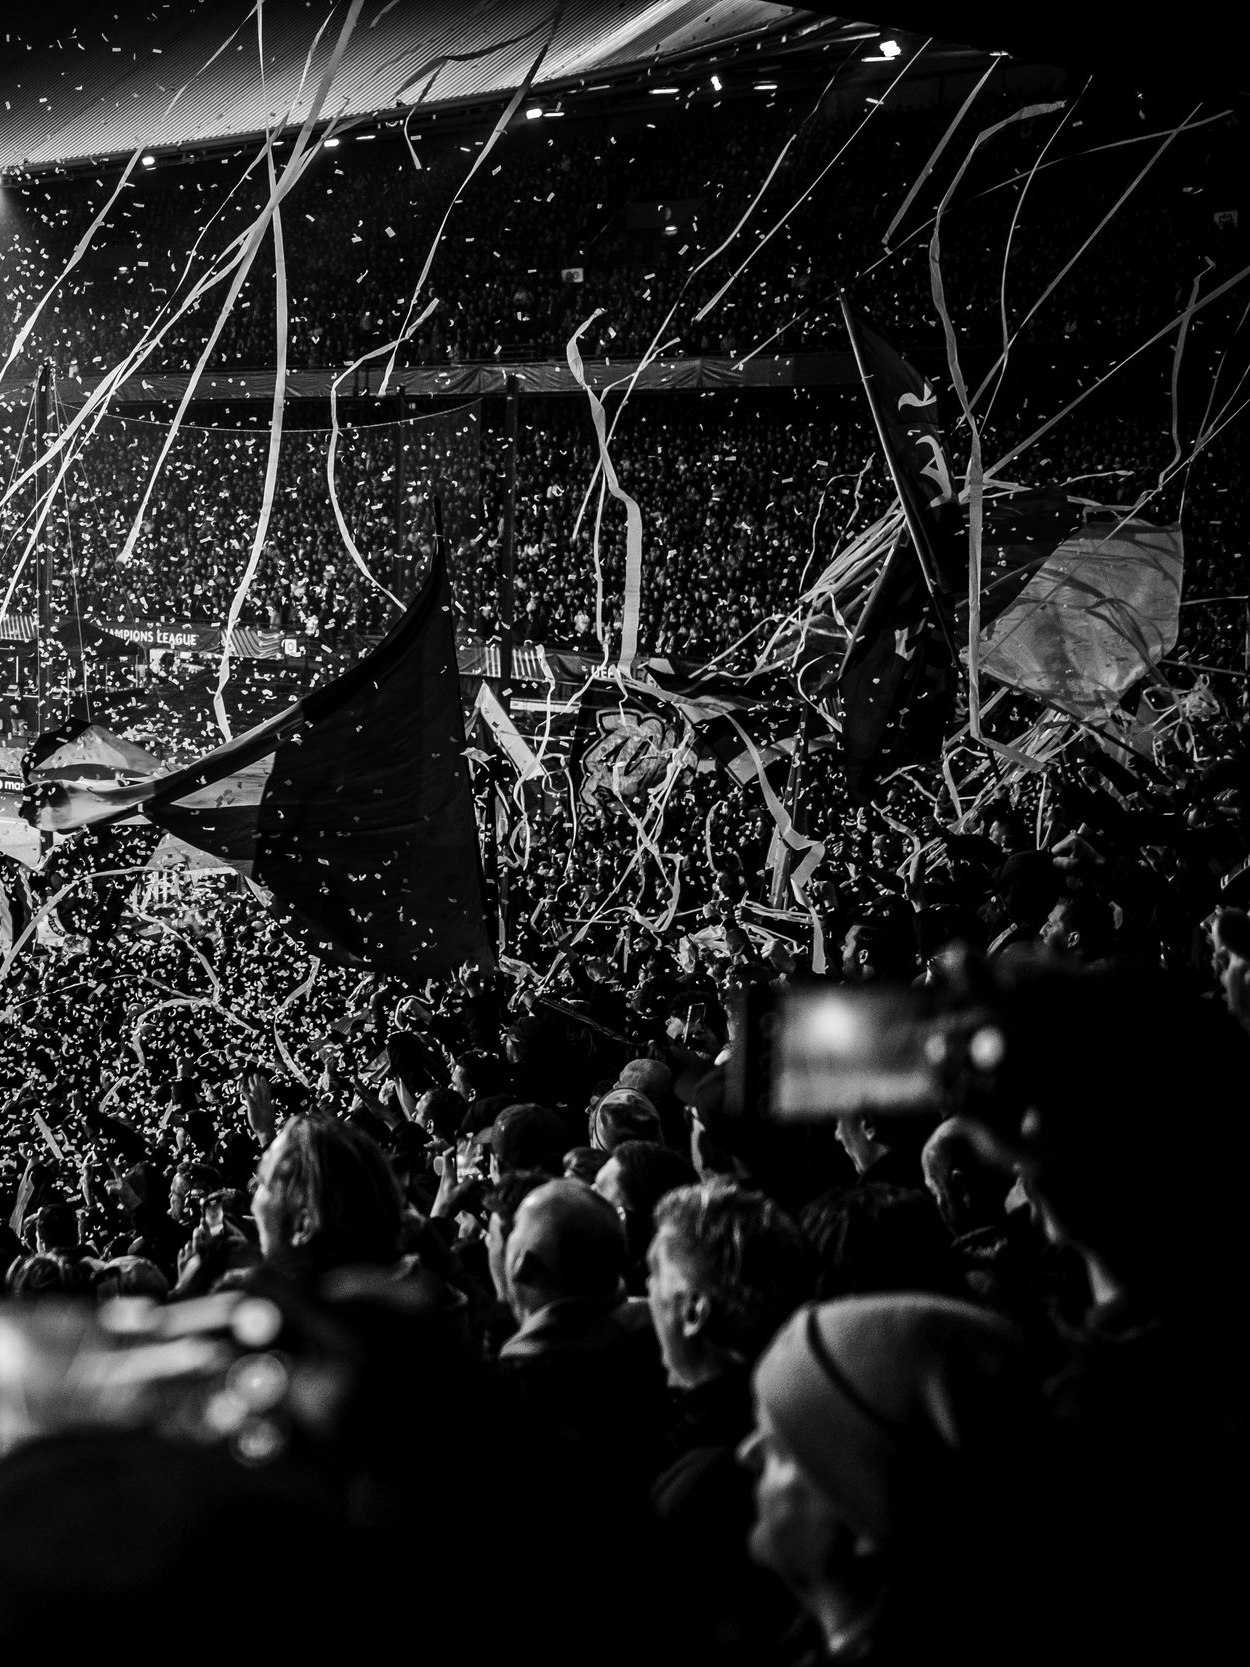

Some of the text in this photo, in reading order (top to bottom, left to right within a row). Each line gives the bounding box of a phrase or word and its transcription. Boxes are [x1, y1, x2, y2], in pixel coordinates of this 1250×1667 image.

[101, 627, 196, 647] AMPIONS LEAGUE
[4, 781, 24, 791] mas
